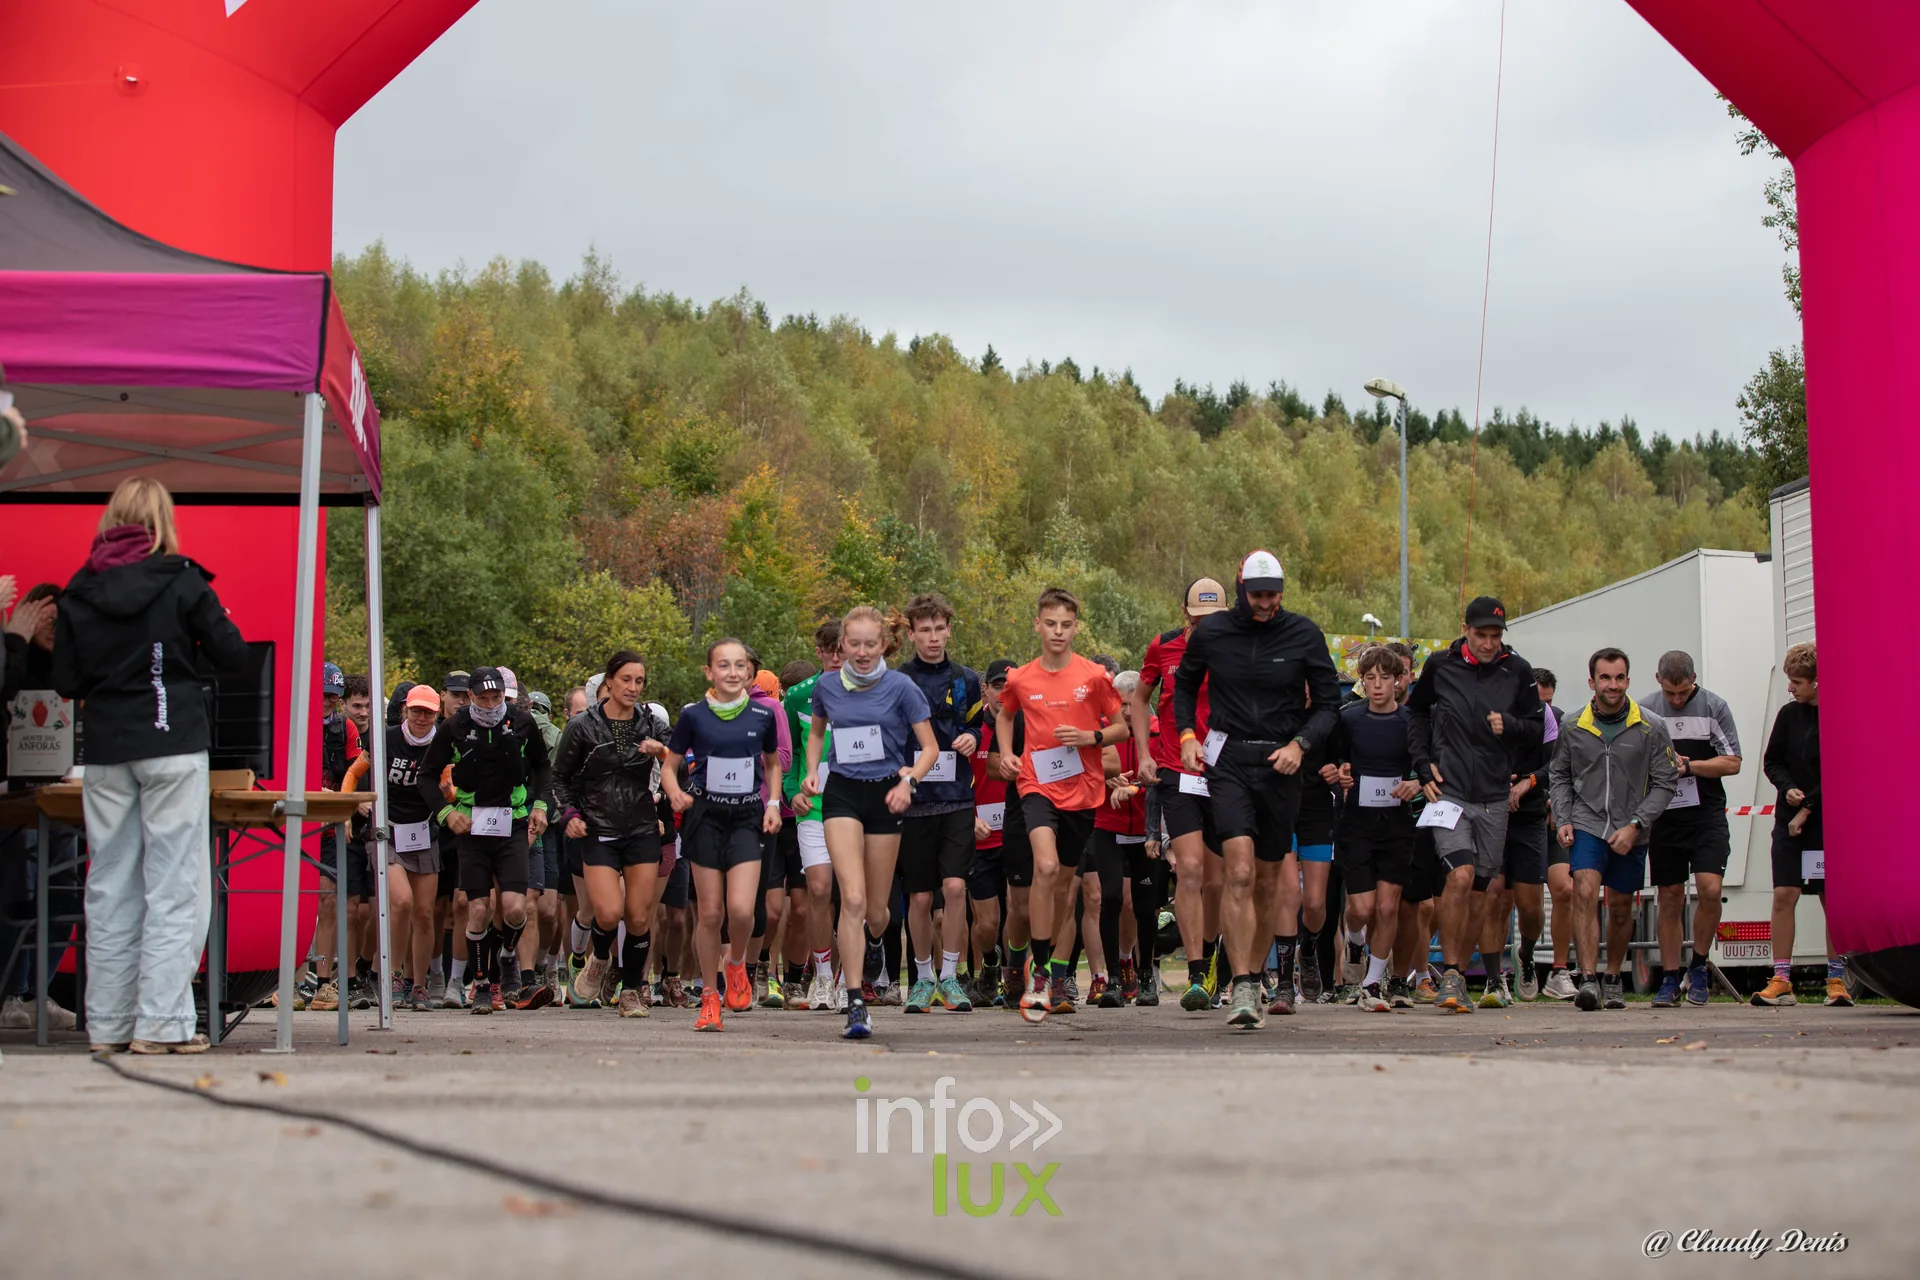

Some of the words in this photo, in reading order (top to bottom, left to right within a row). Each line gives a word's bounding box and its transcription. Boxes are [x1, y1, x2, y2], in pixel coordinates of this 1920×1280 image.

[852, 740, 864, 750] 46
[391, 757, 408, 769] BE
[1051, 759, 1064, 770] 32
[388, 768, 418, 786] RU
[724, 772, 737, 781] 41
[1375, 788, 1386, 797] 93
[706, 793, 740, 805] NIKE
[487, 817, 497, 826] 59
[992, 813, 1002, 821] 51
[410, 832, 417, 842] 8
